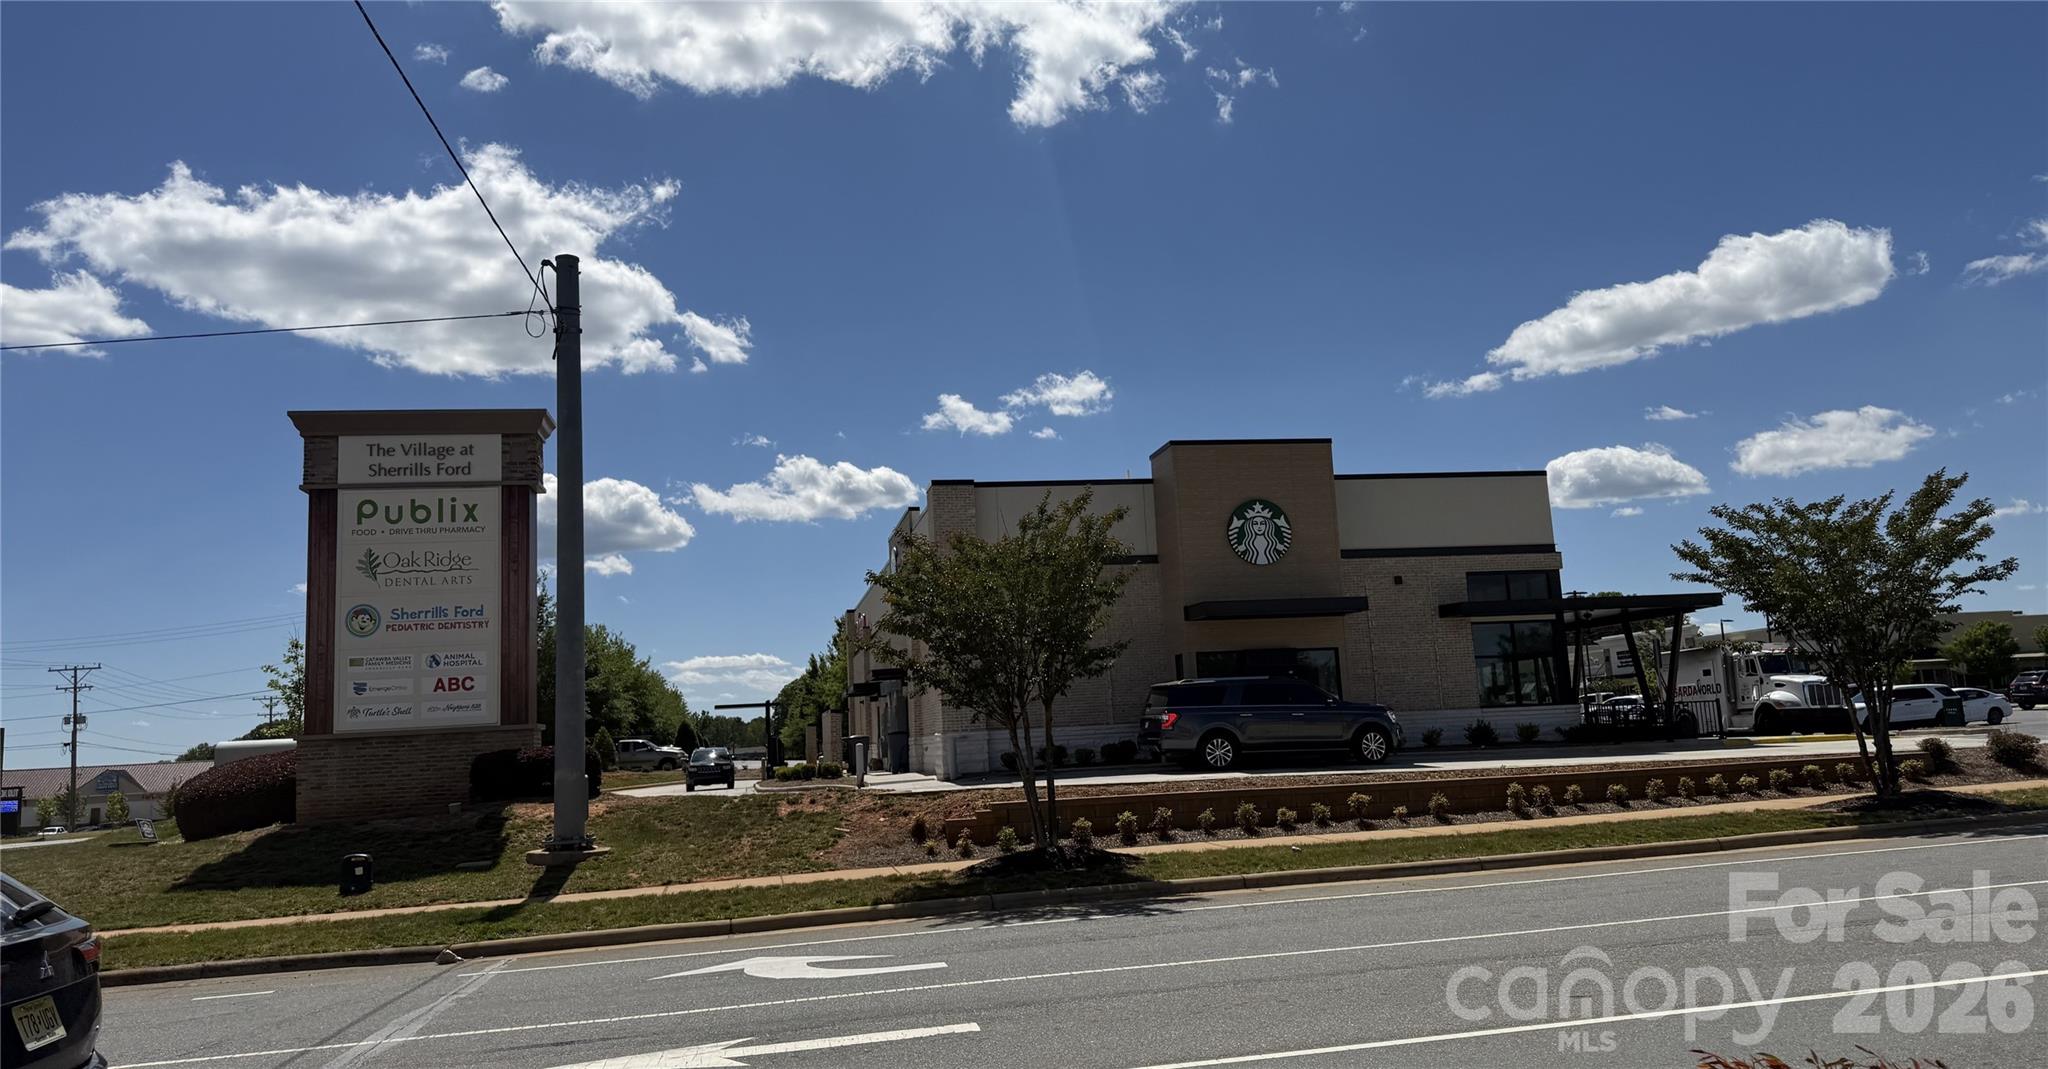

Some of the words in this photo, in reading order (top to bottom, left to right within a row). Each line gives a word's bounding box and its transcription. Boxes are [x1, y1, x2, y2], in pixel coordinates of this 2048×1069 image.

[366, 443, 395, 457] The
[400, 442, 455, 460] Village
[459, 443, 474, 456] at
[368, 463, 431, 477] Sherrills
[437, 461, 471, 476] Ford
[357, 497, 478, 525] Publix
[439, 526, 486, 534] PHARMACY
[383, 551, 421, 568] Oak
[424, 550, 472, 571] Ridge
[384, 577, 436, 587] DENTAL
[442, 575, 473, 586] ARTS
[390, 606, 449, 620] Sherrills
[454, 604, 484, 618] Ford
[385, 622, 435, 632] PEDIATRIC
[438, 619, 490, 630] DENTISTRY
[433, 676, 475, 692] ABC
[362, 707, 391, 718] Turtle's
[391, 706, 412, 717] Shell
